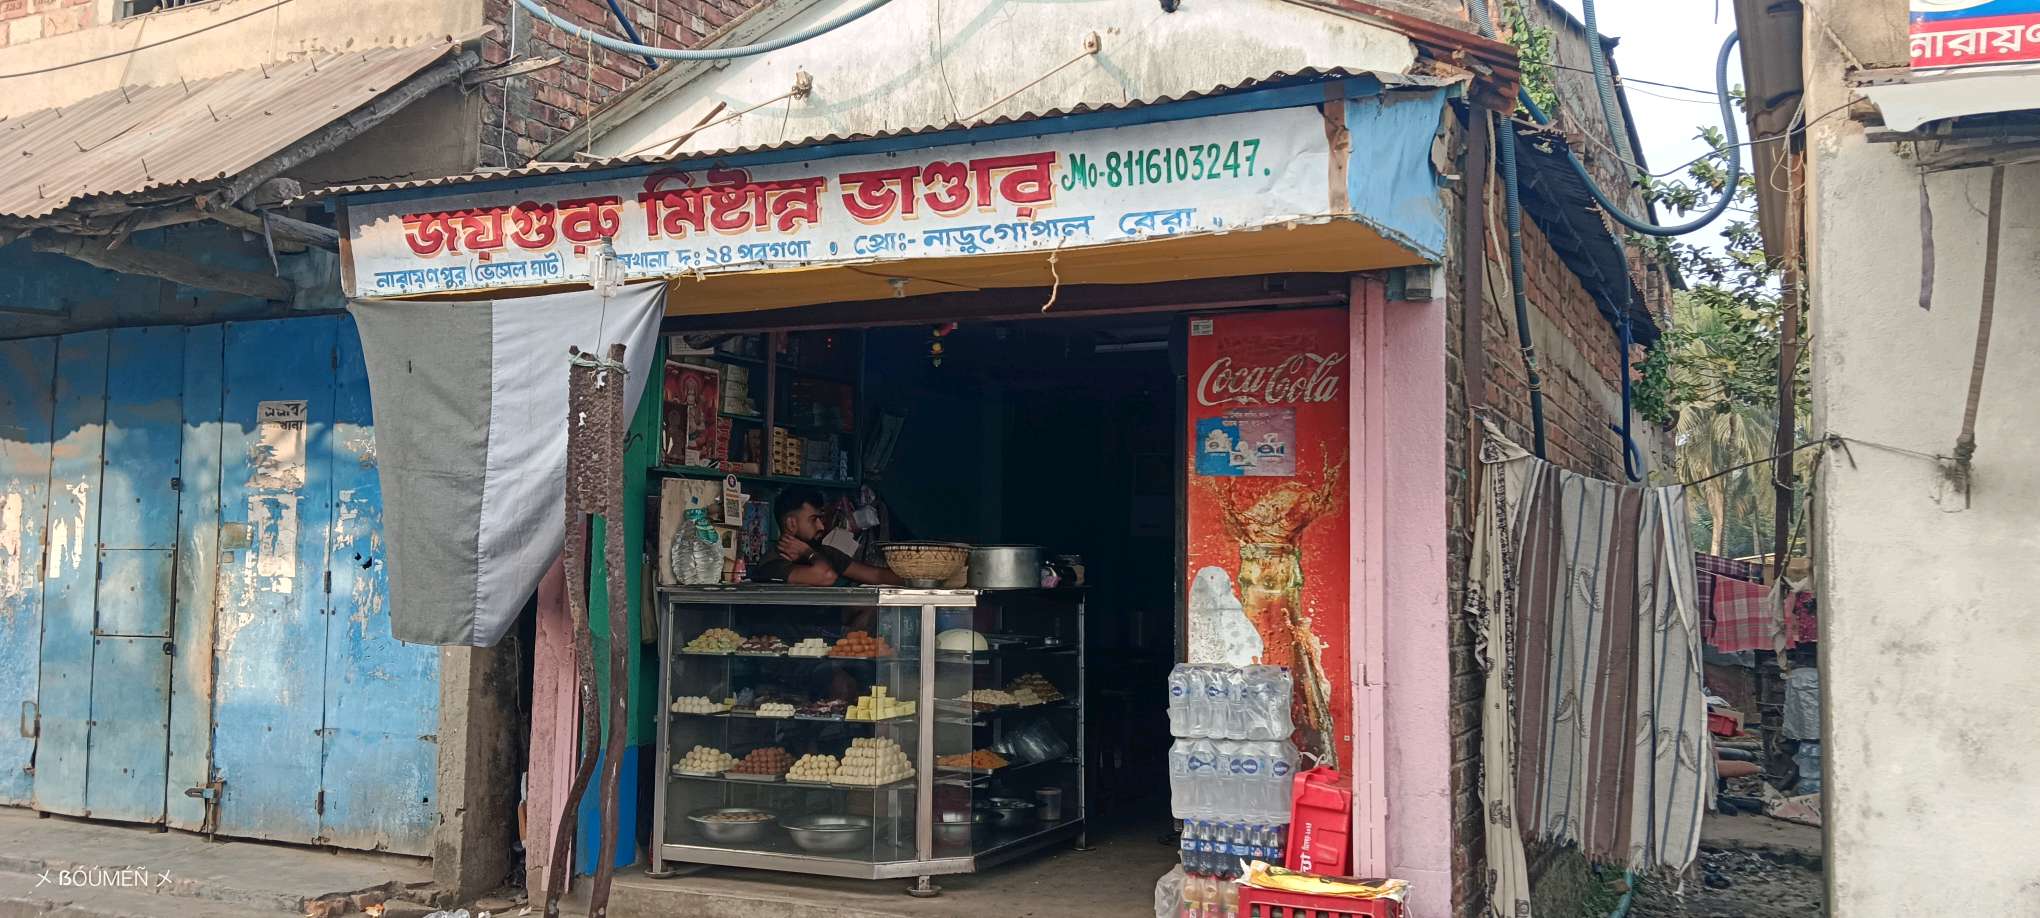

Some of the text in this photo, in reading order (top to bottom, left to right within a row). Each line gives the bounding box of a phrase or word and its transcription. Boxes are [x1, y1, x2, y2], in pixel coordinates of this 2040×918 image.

[401, 151, 1058, 262] জয়গুরু মিষ্টান্ন ভাণ্ডার
[374, 266, 466, 289] নারায়ণপুর
[922, 215, 1095, 253] নাড়ুগোপাল
[1119, 207, 1197, 234] বেরা
[1197, 352, 1348, 407] Coca-Cola
